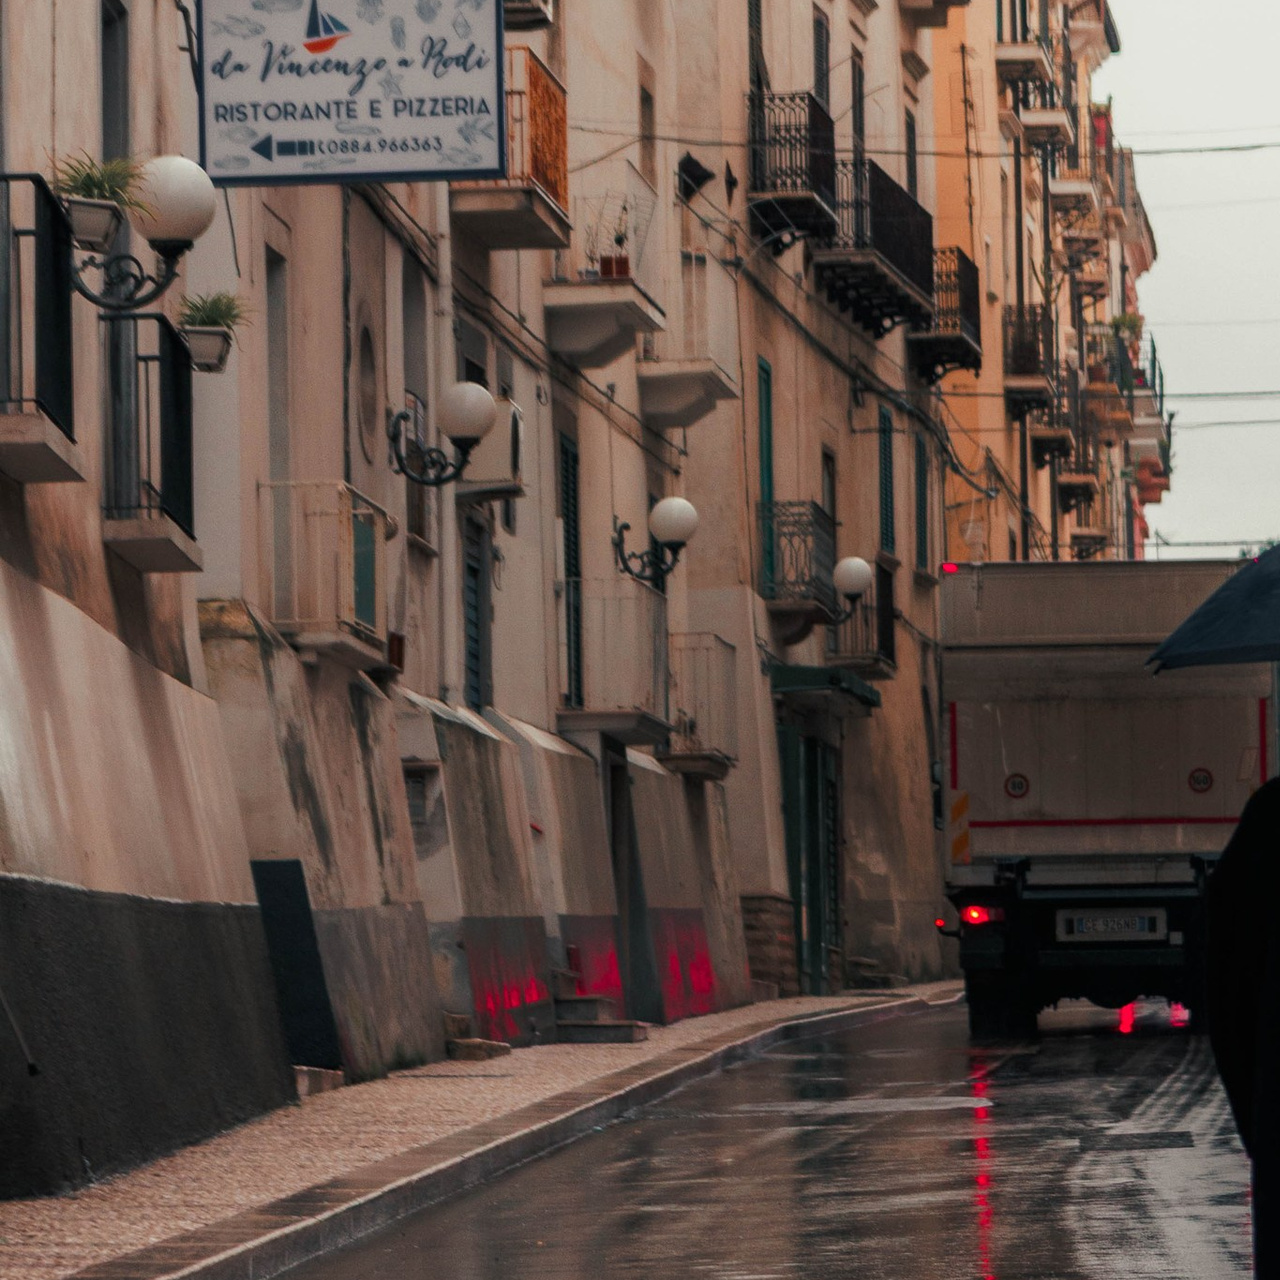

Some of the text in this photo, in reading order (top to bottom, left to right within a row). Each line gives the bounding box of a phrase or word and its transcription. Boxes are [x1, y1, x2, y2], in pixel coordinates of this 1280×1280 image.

[211, 36, 491, 96] da Vincenzo a Rodi
[213, 96, 491, 123] RISTORANTE E PIZZERIA
[327, 136, 443, 155] 0884.966363
